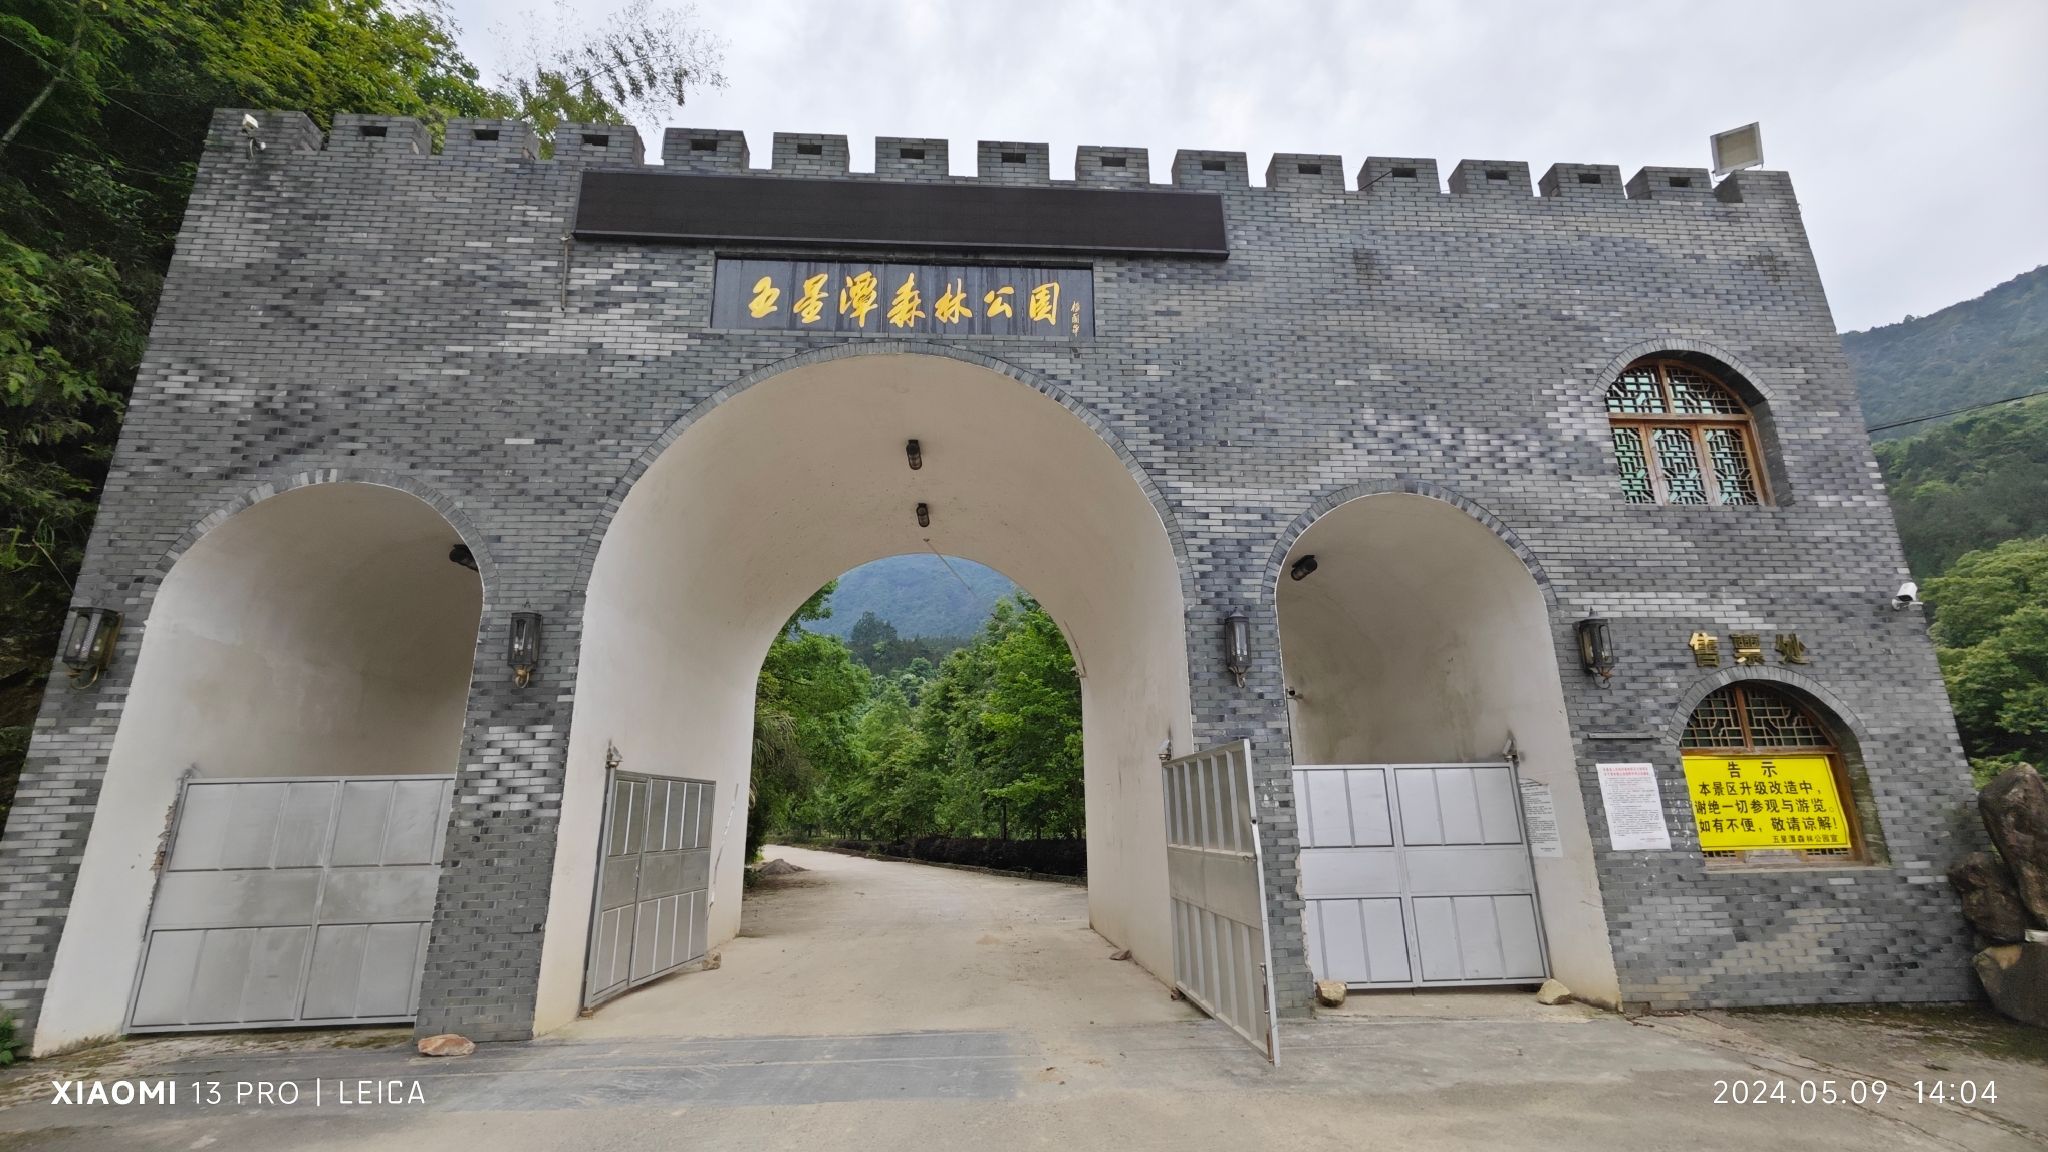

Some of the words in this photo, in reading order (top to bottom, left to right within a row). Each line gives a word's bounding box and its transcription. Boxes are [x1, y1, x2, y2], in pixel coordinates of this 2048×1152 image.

[748, 270, 1060, 328] 五星潭森林公园
[1688, 632, 1810, 667] 售票处
[1699, 780, 1821, 797] 本景区升级改造中，
[1695, 799, 1835, 815] 谢绝一切参观与游览。
